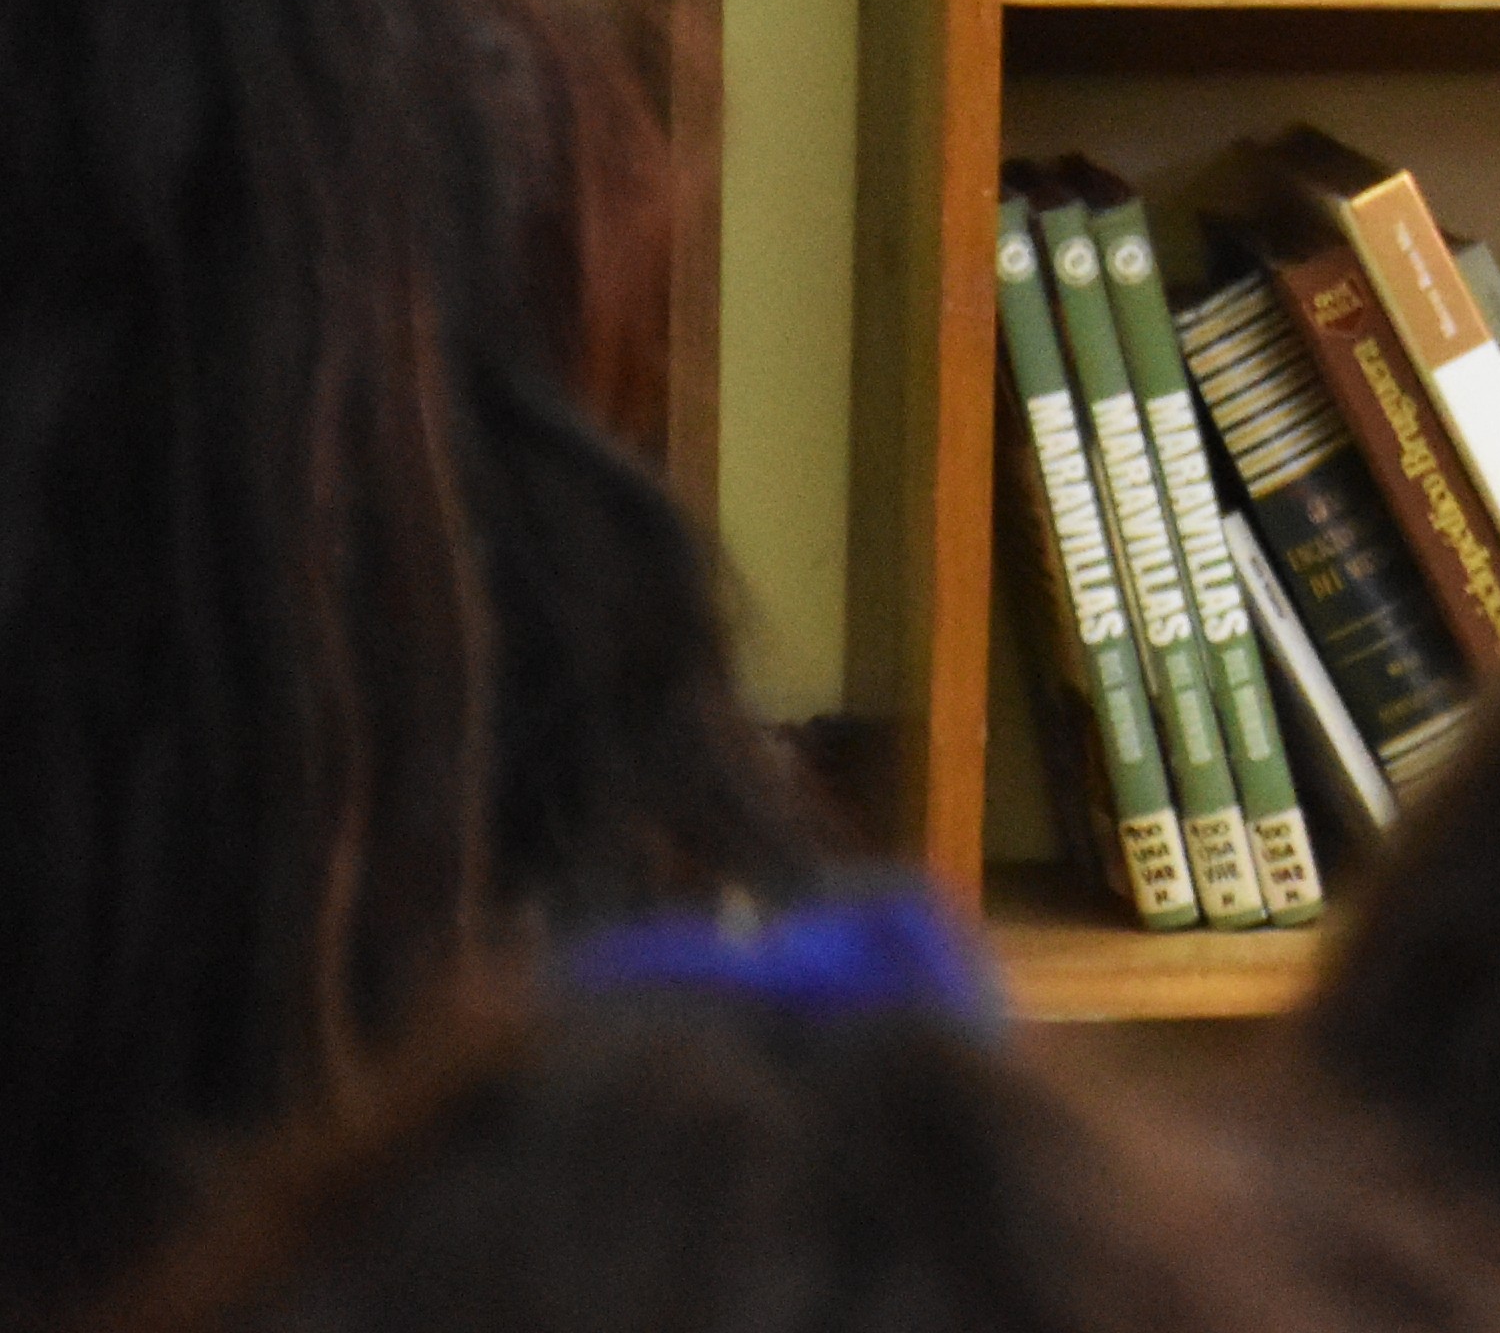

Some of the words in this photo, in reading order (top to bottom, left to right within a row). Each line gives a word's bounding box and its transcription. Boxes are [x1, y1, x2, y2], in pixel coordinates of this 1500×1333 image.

[1023, 388, 1128, 645] MARAVILLAS
[1090, 392, 1193, 648] MARAVILLAS
[1145, 390, 1248, 645] MARAVILLAS
